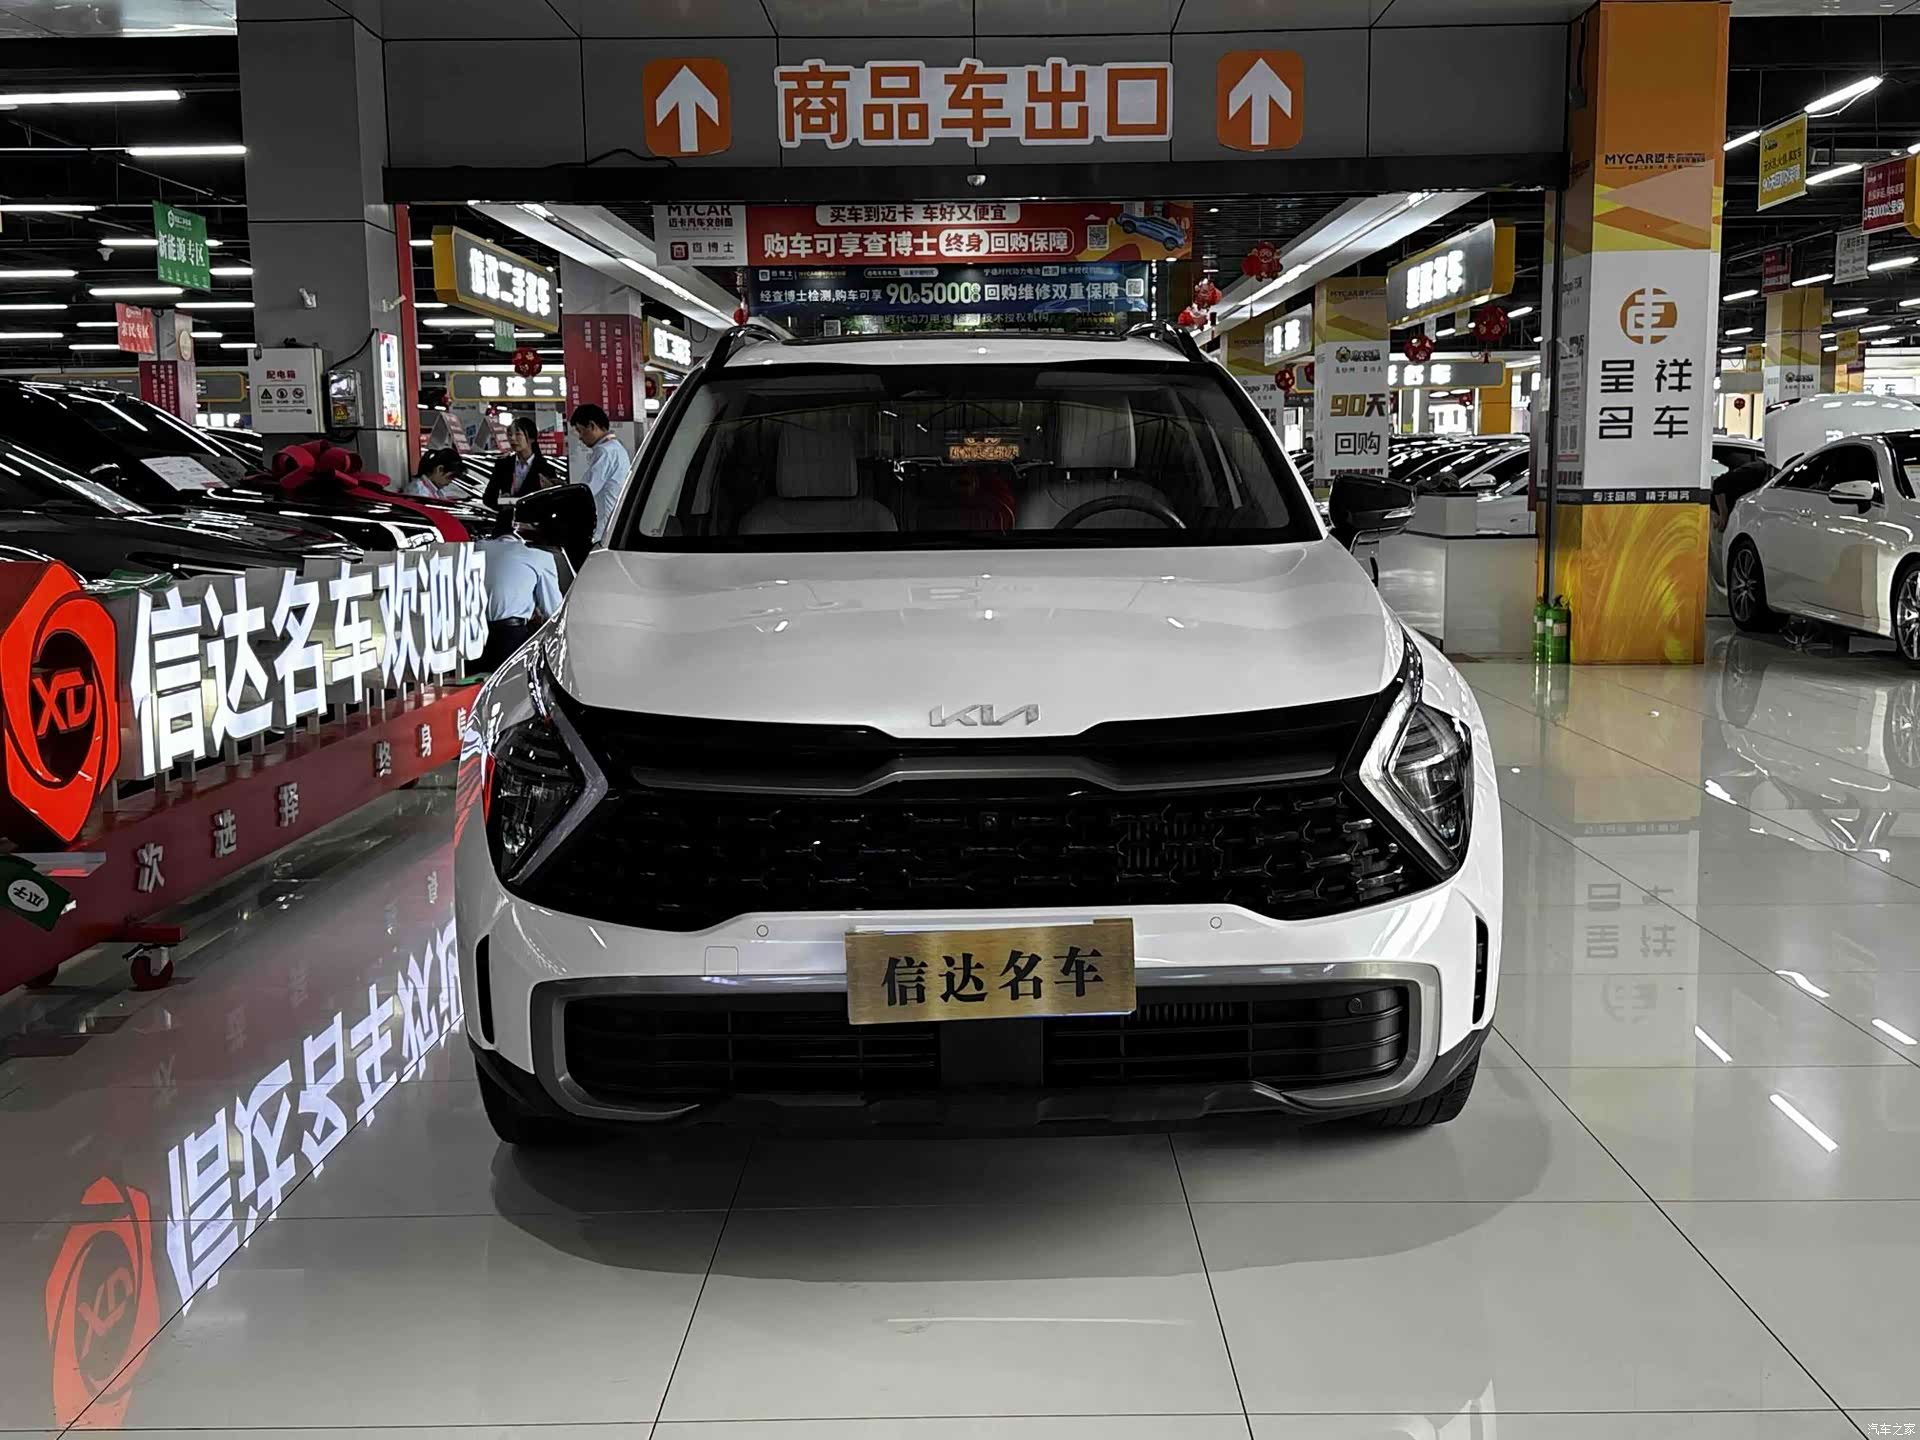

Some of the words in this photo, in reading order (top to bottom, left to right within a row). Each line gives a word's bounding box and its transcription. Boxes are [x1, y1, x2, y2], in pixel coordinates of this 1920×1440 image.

[777, 59, 1171, 147] 商品车出口
[829, 204, 914, 223] 买车到迈卡
[922, 203, 1007, 221] 车好又便宜
[158, 231, 206, 267] 新能源专区
[266, 370, 297, 380] 配电箱
[1600, 358, 1693, 394] 呈祥
[1330, 393, 1386, 417] 90天
[1598, 405, 1690, 440] 名车
[1334, 431, 1382, 457] 回购
[1592, 490, 1637, 502] 专注品质
[130, 542, 488, 778] 信达名车欢迎您
[928, 703, 1041, 727] KIA
[13, 886, 45, 908] 瓜子
[880, 945, 1104, 1007] 信达名车
